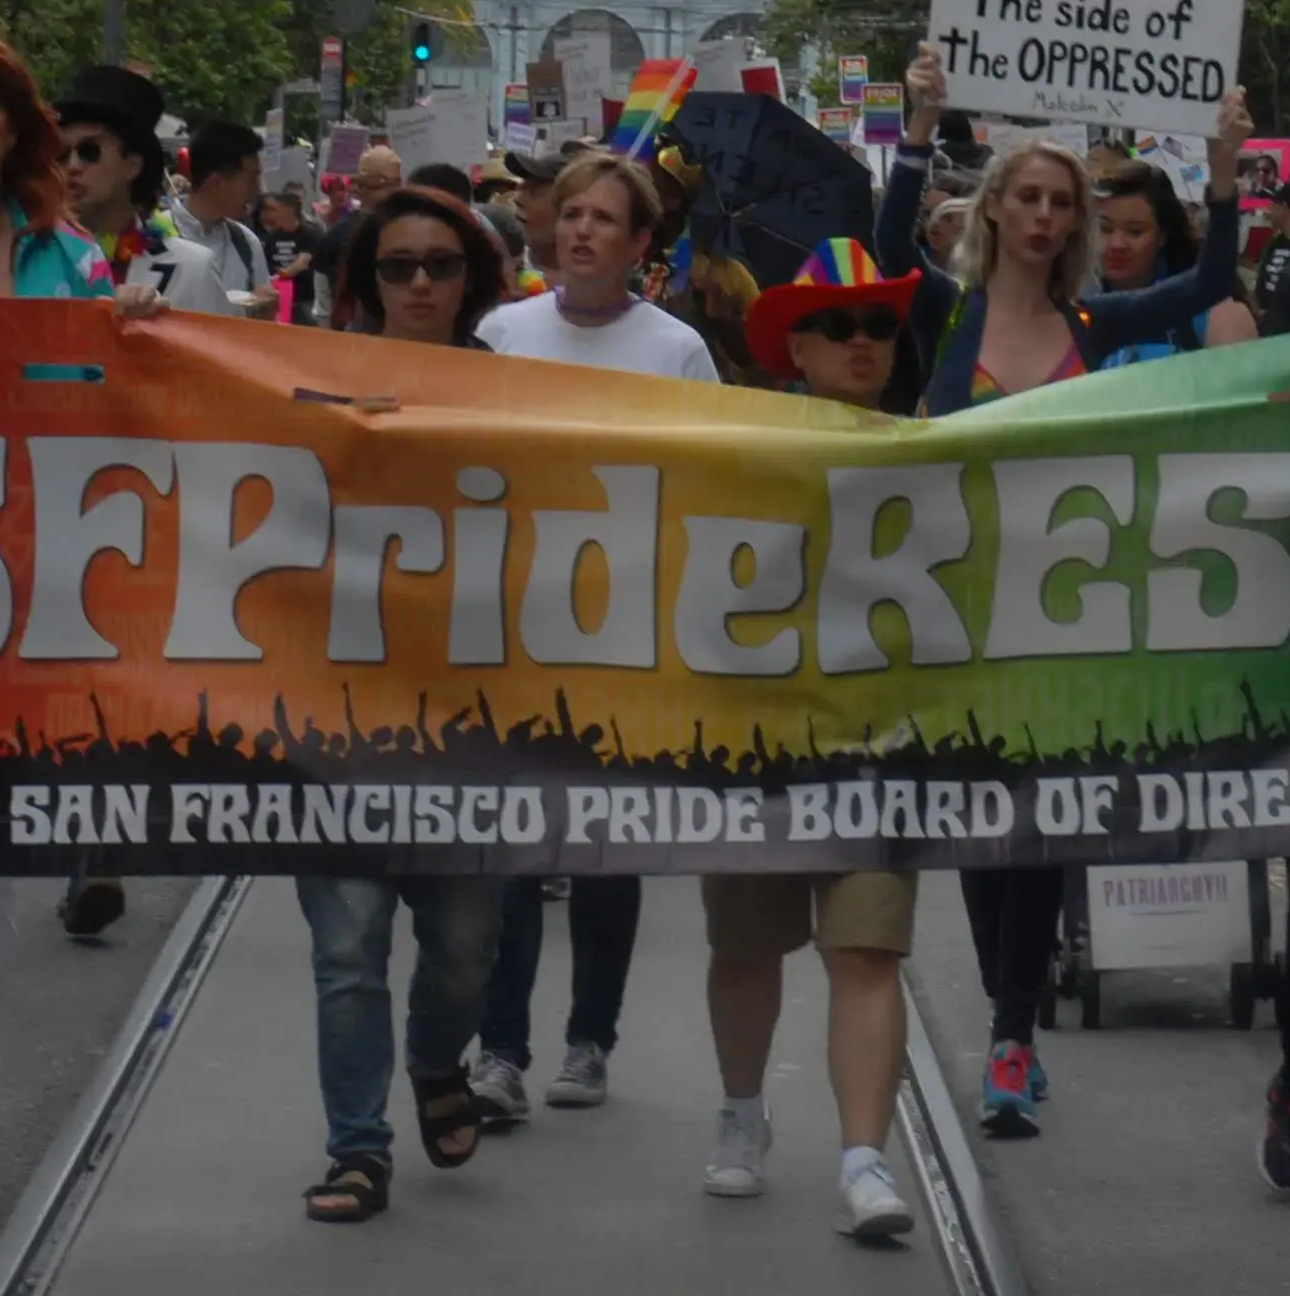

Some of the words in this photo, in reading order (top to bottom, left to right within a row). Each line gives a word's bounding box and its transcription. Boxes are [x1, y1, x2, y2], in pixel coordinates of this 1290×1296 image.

[938, 26, 1009, 79] the
[1017, 37, 1224, 103] OPPRESSED
[9, 784, 150, 845] SAN
[170, 785, 546, 845] FRANCISCO
[565, 784, 766, 844] PRIDE
[786, 778, 1016, 843] BOARD
[1035, 774, 1120, 838] OF
